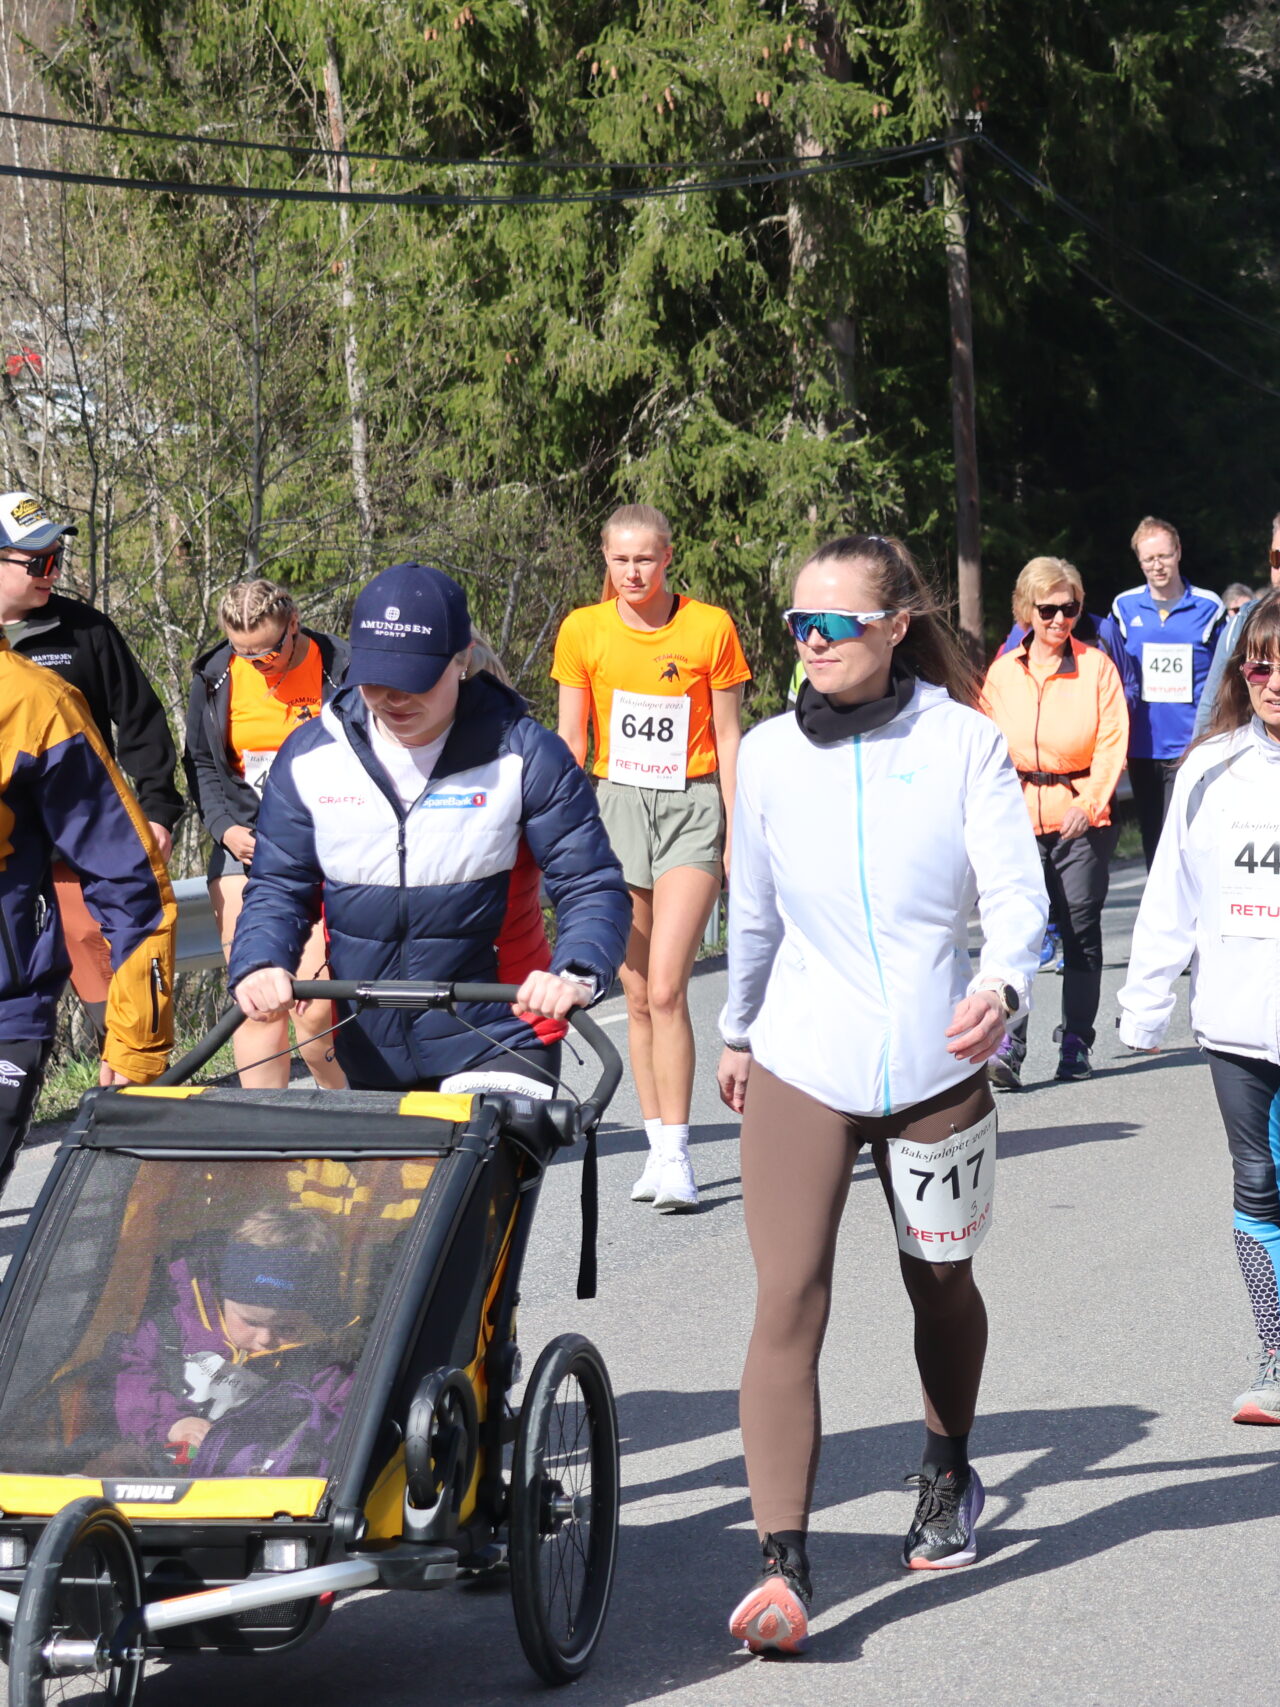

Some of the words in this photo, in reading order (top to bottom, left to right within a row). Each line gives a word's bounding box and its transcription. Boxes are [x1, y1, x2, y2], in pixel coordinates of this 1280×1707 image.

[360, 620, 432, 635] AMUNDSEN
[375, 630, 406, 638] SPORTS
[1149, 657, 1183, 673] 426
[621, 714, 674, 742] 648
[615, 759, 672, 774] RETURA
[0, 1075, 20, 1088] bro
[909, 1148, 985, 1202] 717
[906, 1213, 986, 1243] RETURA
[115, 1484, 176, 1499] THULE
